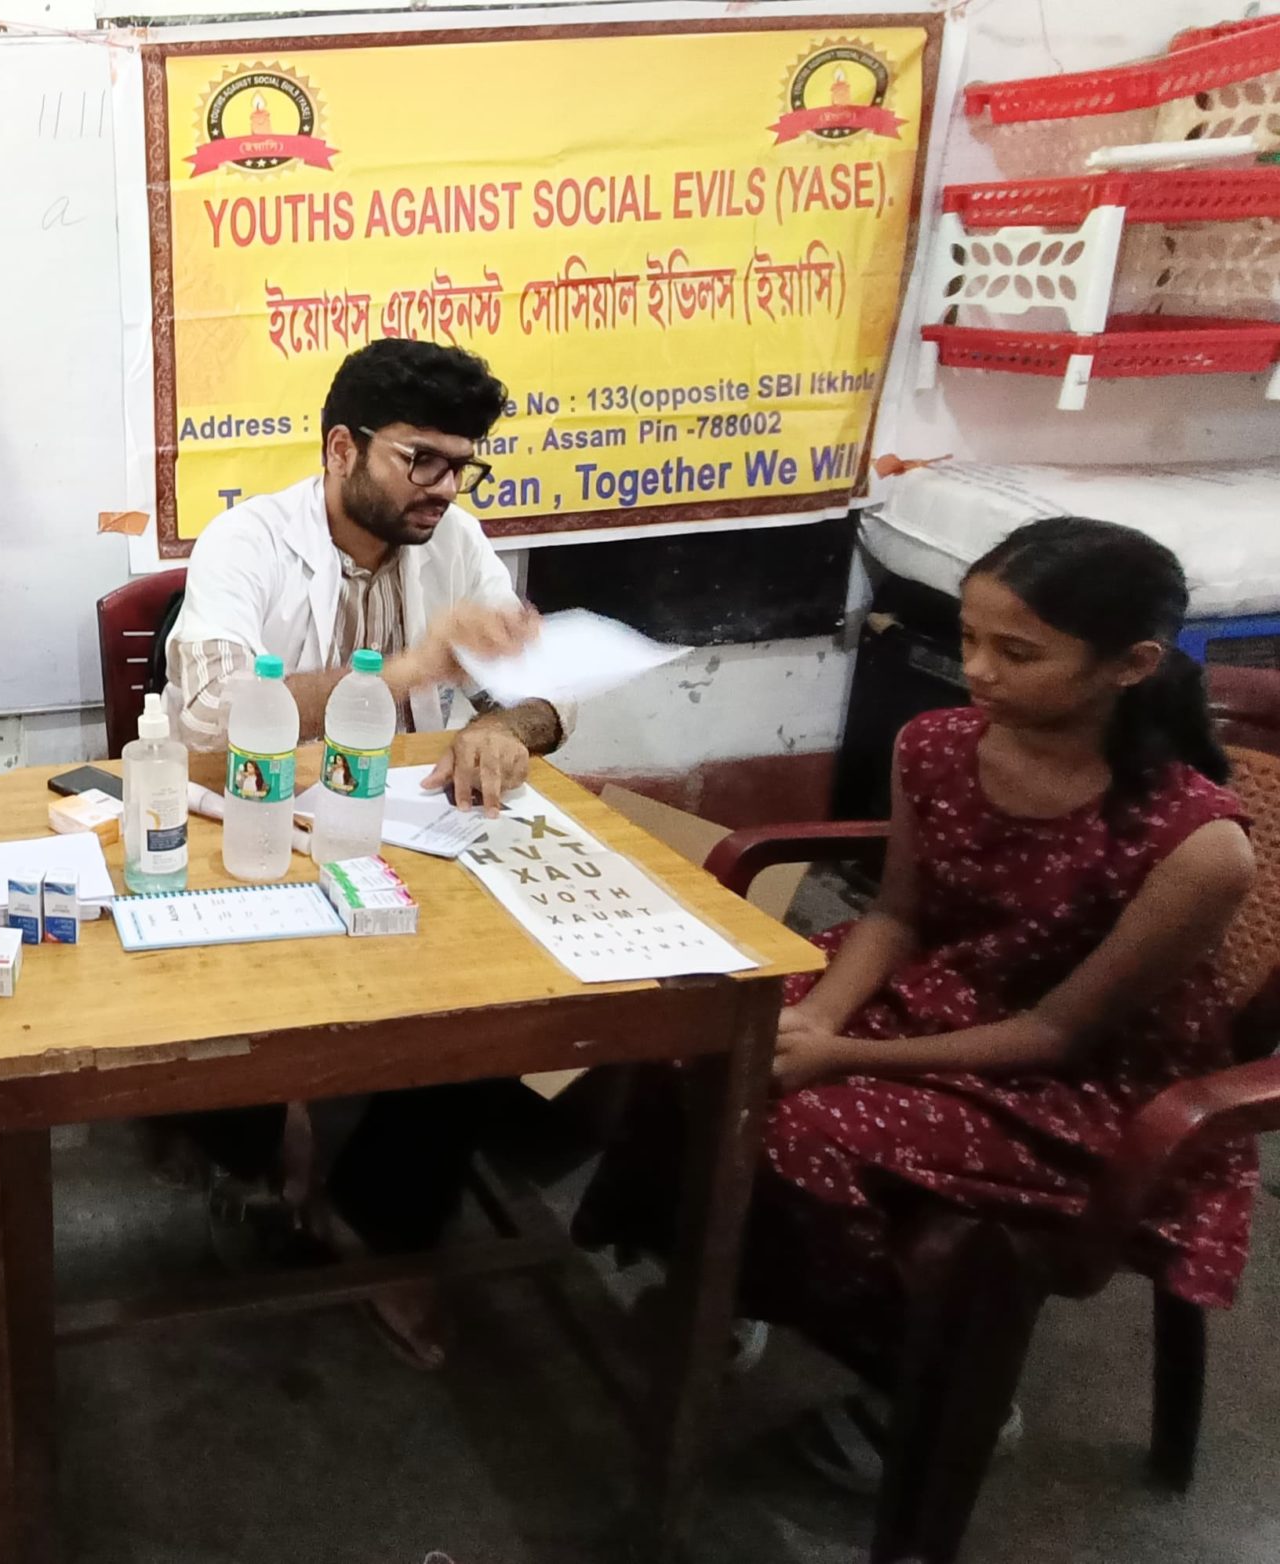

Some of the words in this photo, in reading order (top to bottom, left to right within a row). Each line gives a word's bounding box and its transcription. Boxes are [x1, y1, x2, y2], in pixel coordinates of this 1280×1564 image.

[204, 190, 355, 248] YOUTHS
[364, 182, 522, 238] AGAINST
[533, 174, 662, 228] SOCIAL
[673, 167, 766, 219] EVILS
[526, 391, 560, 416] No
[757, 372, 802, 399] SBI
[179, 412, 292, 441] Address
[542, 426, 626, 452] Assam
[639, 419, 678, 444] Pin
[471, 472, 540, 509] Can
[575, 456, 733, 506] Together
[744, 450, 798, 487] We
